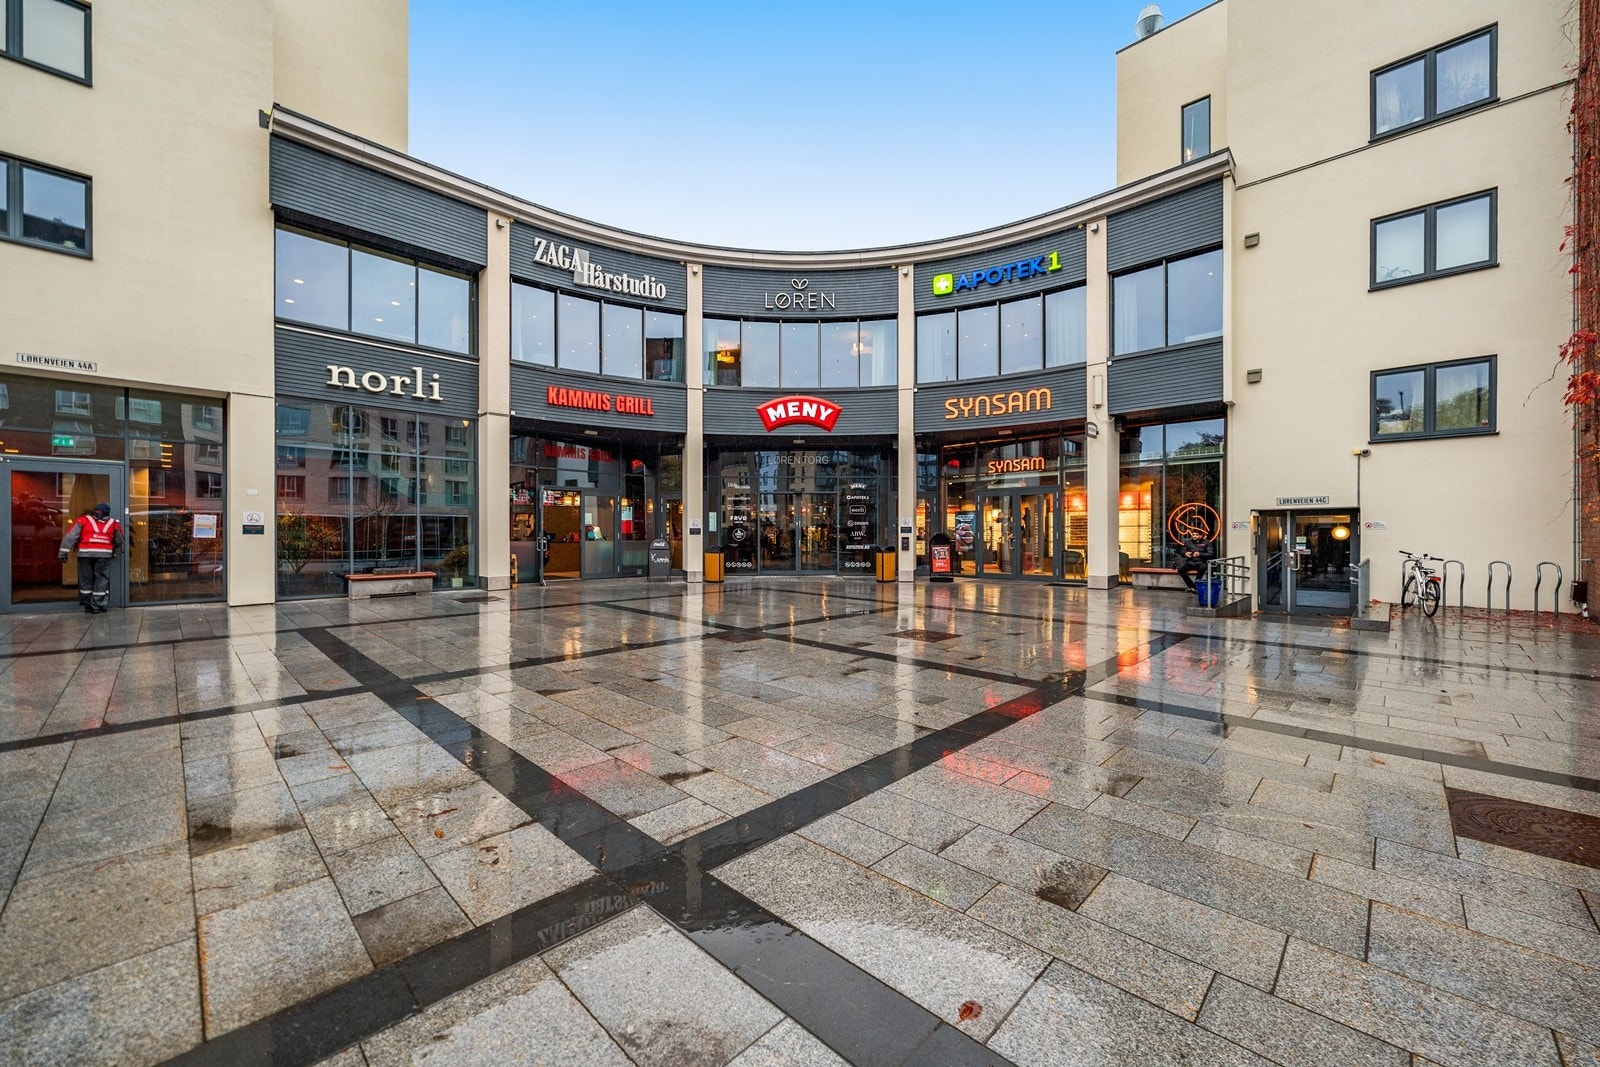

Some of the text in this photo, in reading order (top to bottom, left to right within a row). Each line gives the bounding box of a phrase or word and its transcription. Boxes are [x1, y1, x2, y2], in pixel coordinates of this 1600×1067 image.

[534, 237, 583, 273] ZAGA
[582, 261, 667, 299] Hårstudio
[955, 255, 1046, 292] APOTEK
[764, 292, 836, 309] LØREN
[21, 354, 93, 371] LØRENVEIEN 44A
[326, 365, 444, 401] norli
[547, 386, 656, 416] KAMMIS GRILL
[766, 401, 834, 423] MENY
[944, 387, 1052, 419] SYNSAM
[544, 442, 614, 463] KAMMIS GRILL
[803, 455, 829, 465] TORG
[988, 456, 1046, 474] SYNSAM
